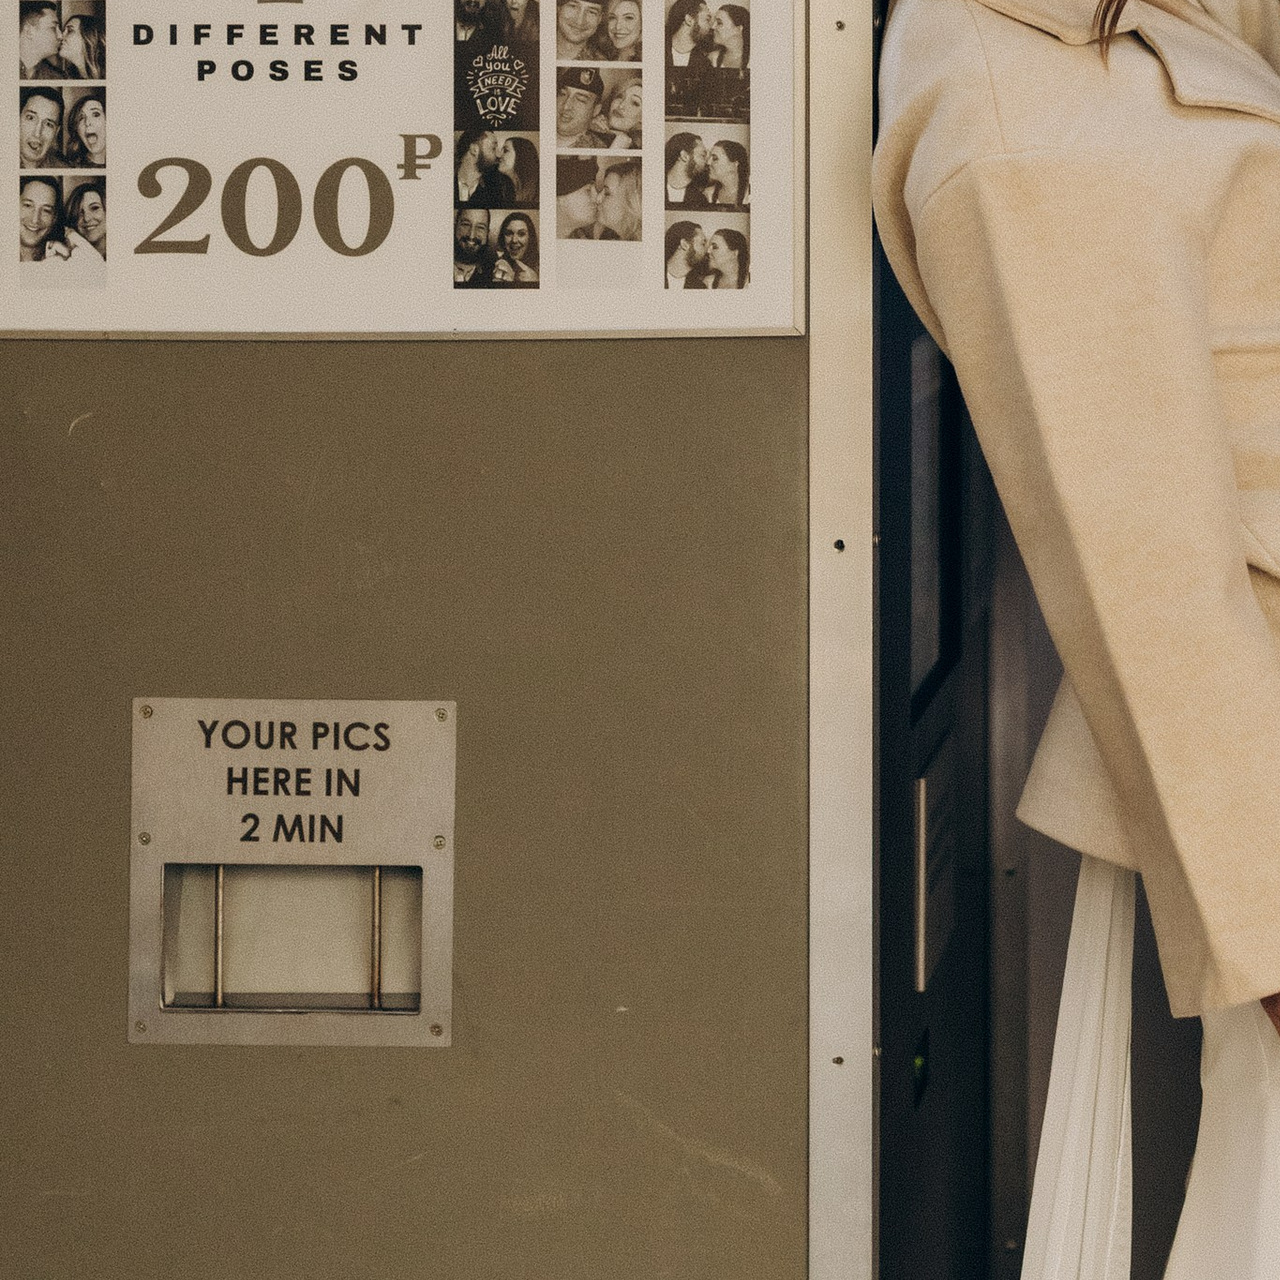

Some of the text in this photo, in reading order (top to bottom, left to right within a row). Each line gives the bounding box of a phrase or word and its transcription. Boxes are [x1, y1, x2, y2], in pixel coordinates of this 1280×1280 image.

[133, 24, 423, 46] DIFFERENT
[486, 45, 509, 60] All
[197, 59, 359, 82] POSES
[479, 62, 511, 76] you
[484, 75, 512, 87] NEED
[476, 96, 521, 115] LOVE
[198, 720, 391, 751] YOUR PICS
[226, 767, 361, 797] HERE IN
[239, 813, 344, 843] 2 MIN
